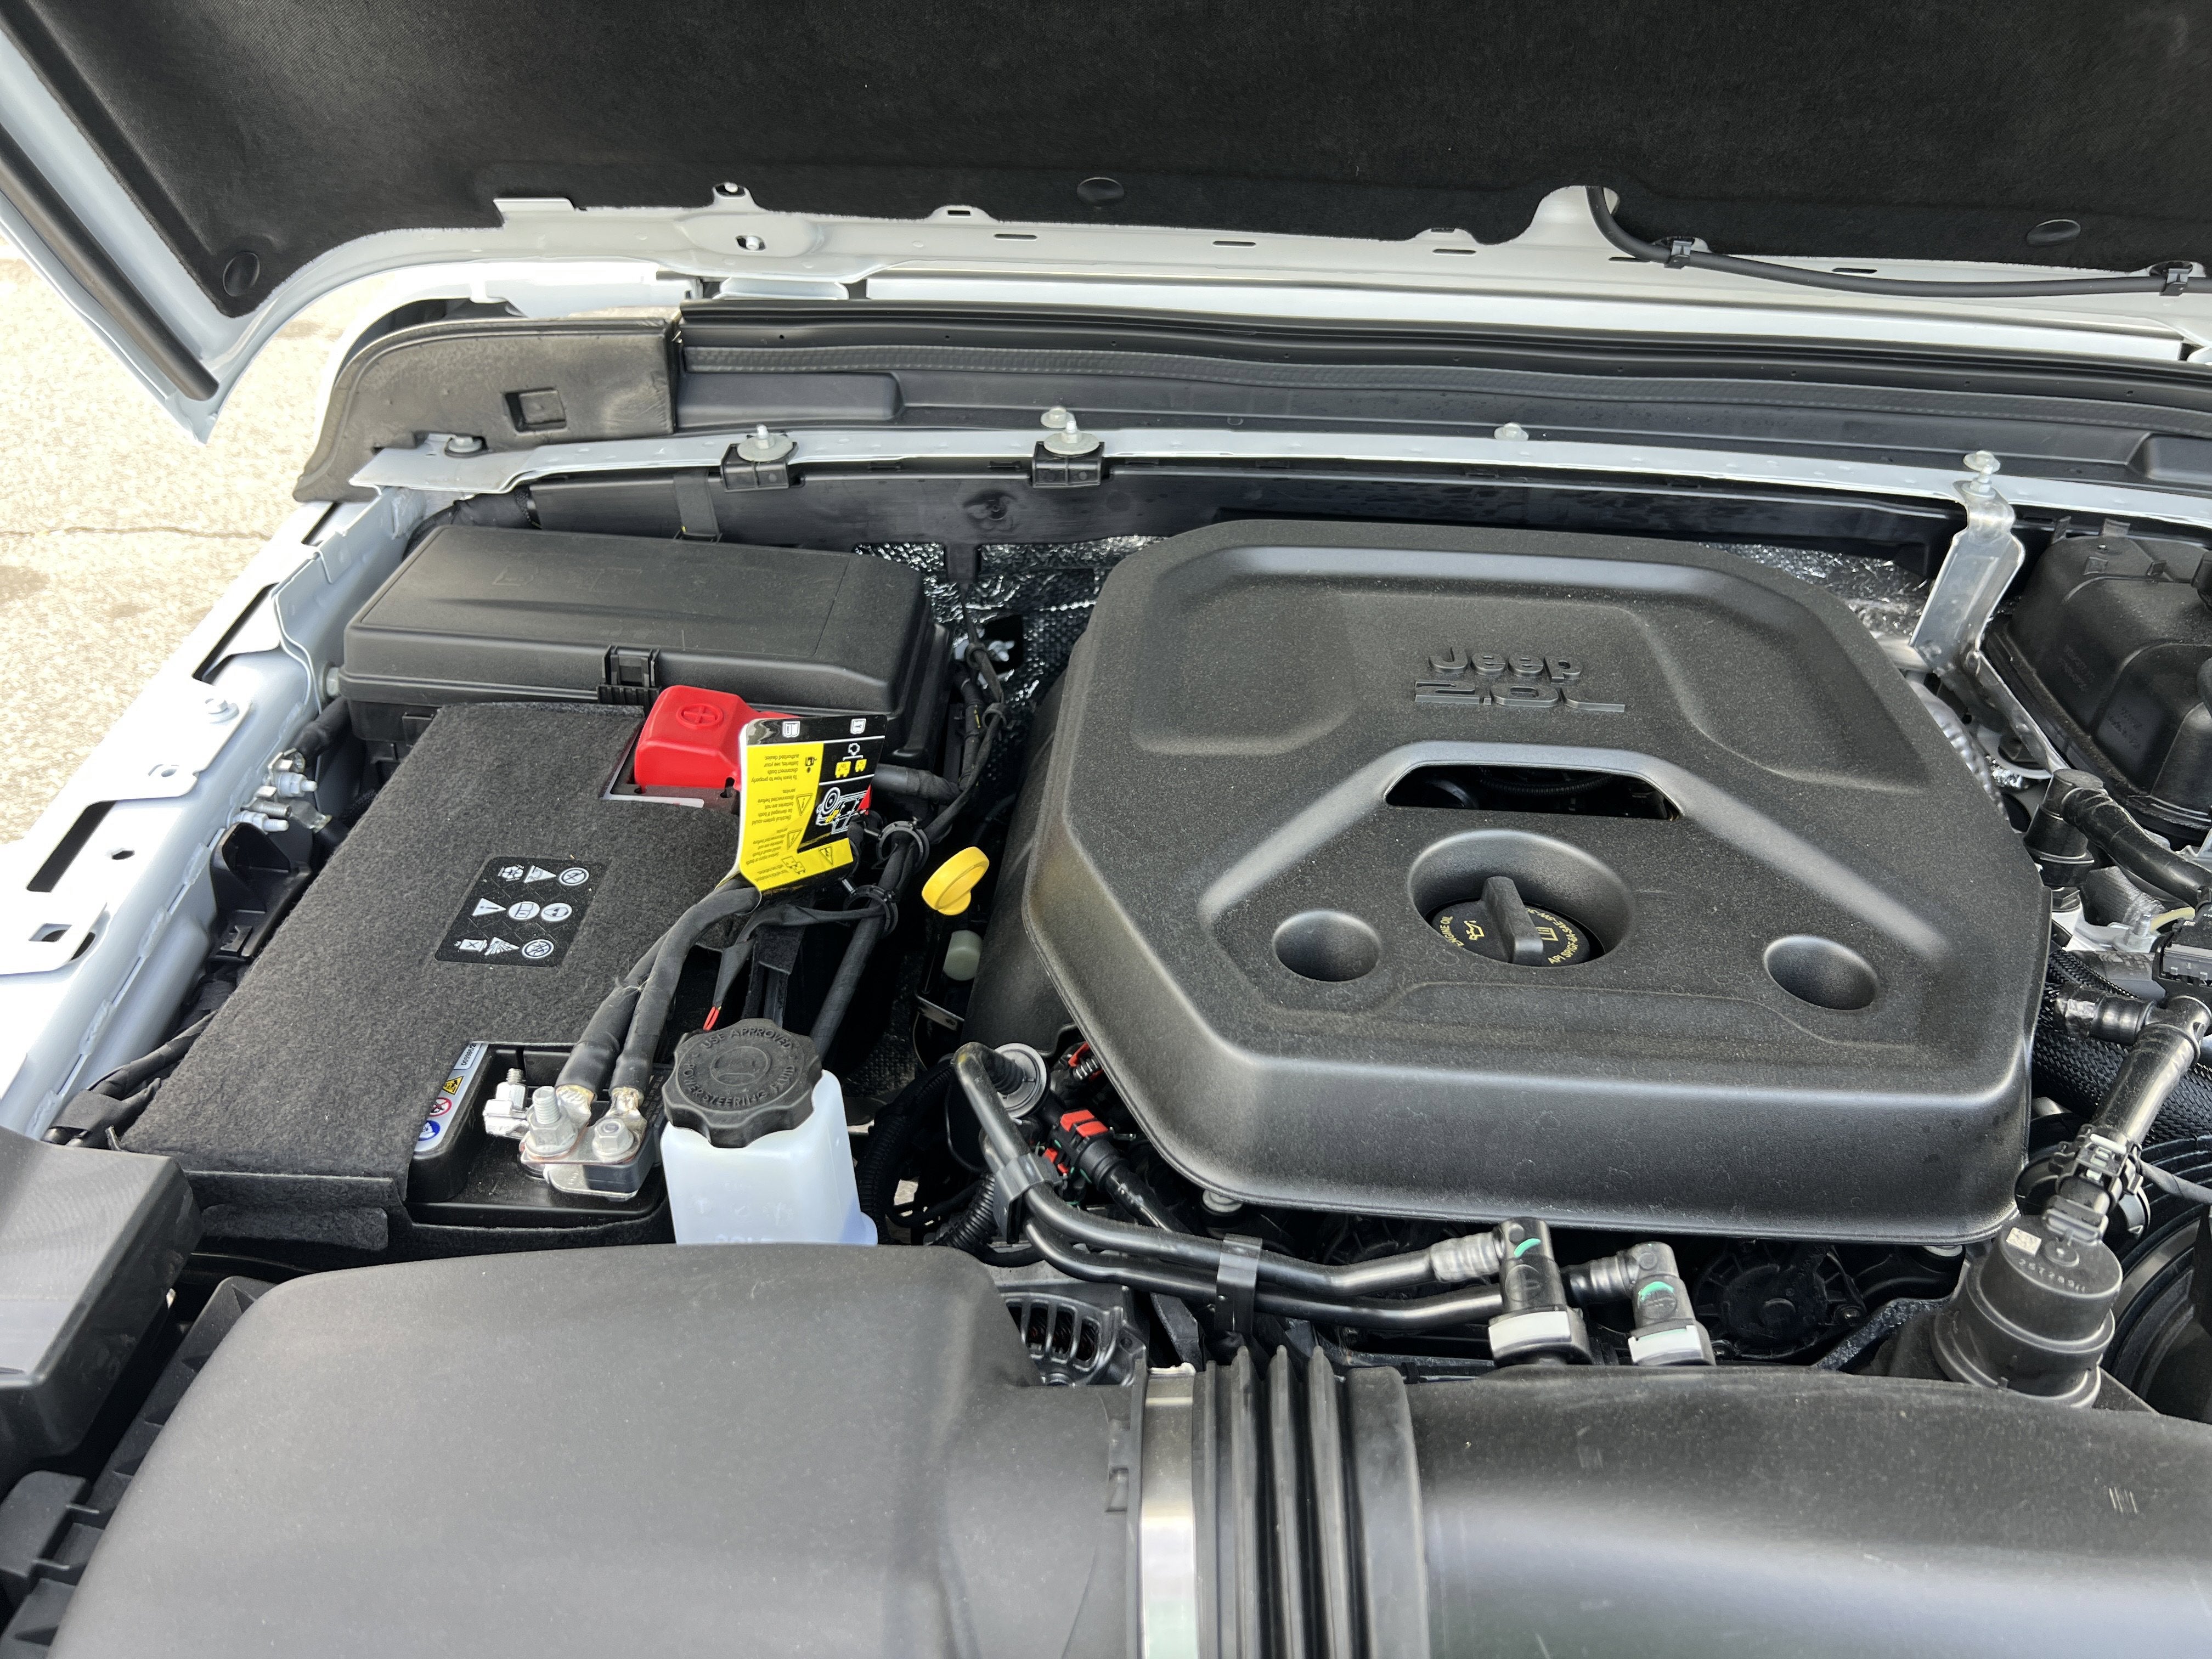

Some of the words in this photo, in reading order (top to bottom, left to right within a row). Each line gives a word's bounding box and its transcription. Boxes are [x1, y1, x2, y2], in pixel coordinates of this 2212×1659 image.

[1429, 647, 1583, 684] Jeep
[1414, 680, 1625, 713] 2.0L
[1440, 916, 1453, 924] OIL
[1440, 924, 1464, 947] ENGINE
[1547, 954, 1566, 964] API
[700, 1032, 726, 1049] USE
[729, 1026, 794, 1049] APPROVED
[682, 1063, 703, 1095] POWER
[703, 1090, 768, 1107] STEERING
[769, 1064, 795, 1094] FLUID
